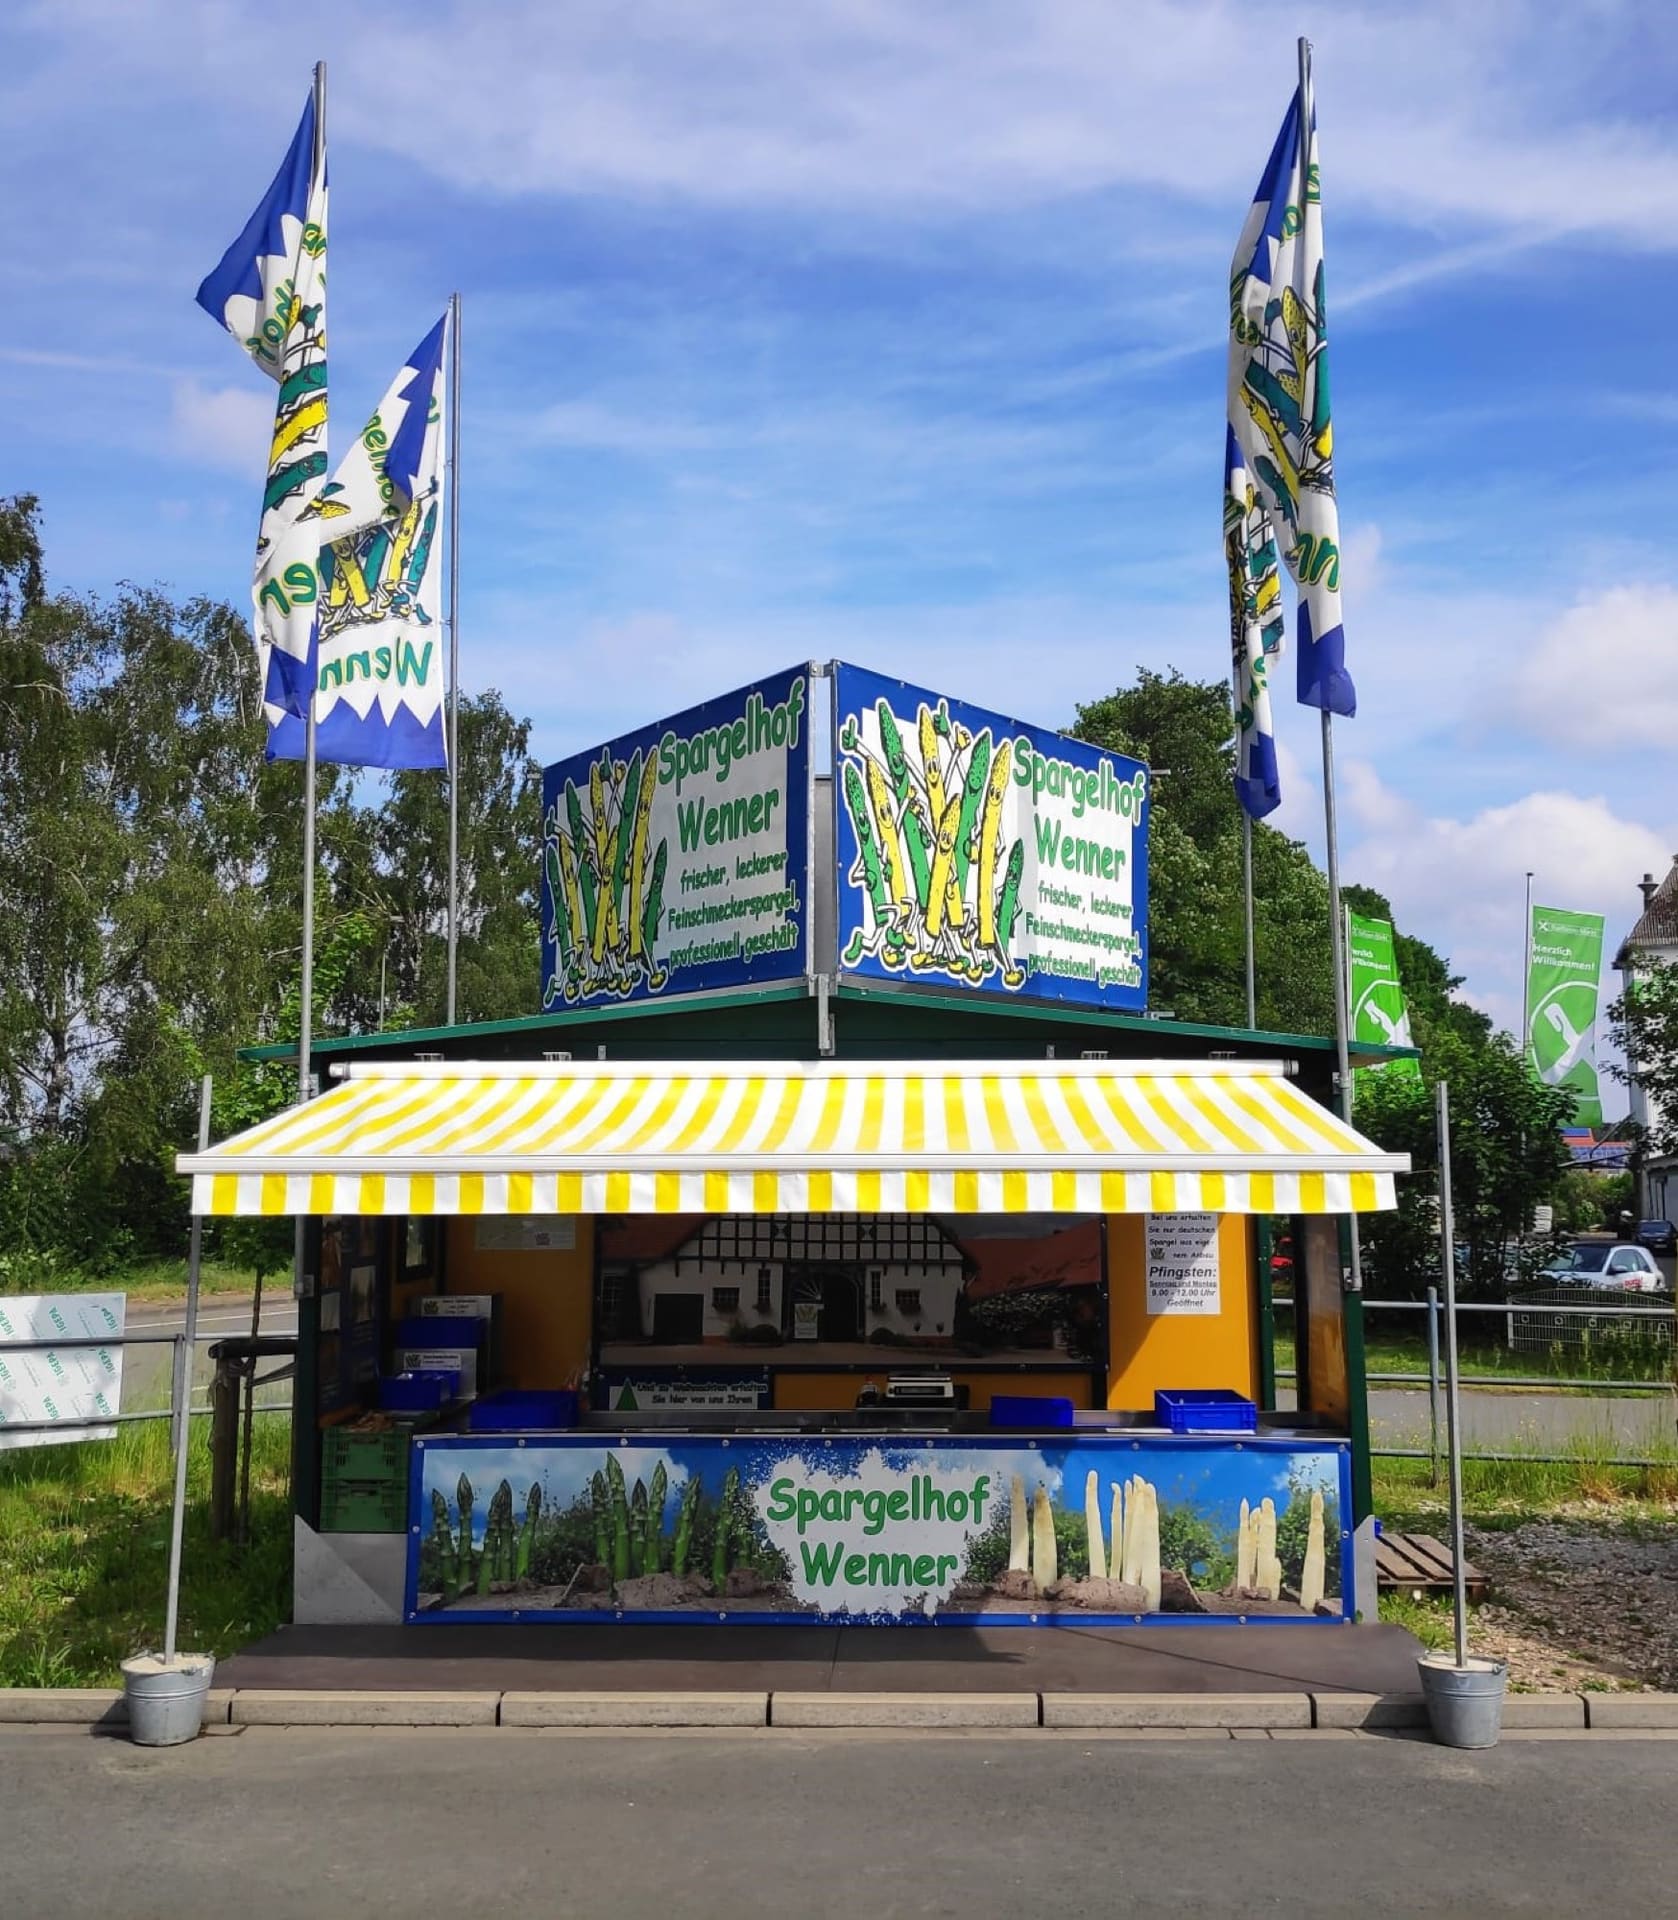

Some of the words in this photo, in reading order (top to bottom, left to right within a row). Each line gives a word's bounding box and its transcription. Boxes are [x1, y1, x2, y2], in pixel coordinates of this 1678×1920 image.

[658, 679, 804, 796] Spargelhof
[1013, 738, 1144, 825] Spargelhof
[677, 788, 779, 853] Wenner
[1034, 813, 1126, 882] Wenner
[681, 867, 730, 893] frischer,
[736, 851, 788, 879] leckerer
[668, 880, 801, 931] Feinschmeckerspargel,
[1038, 880, 1085, 914] frischer,
[1091, 890, 1133, 919] leckerer
[669, 932, 740, 972] professionell
[744, 921, 798, 963] geschält
[1025, 915, 1142, 958] Feinschmeckerspargel,
[1028, 951, 1095, 982] professionell
[1099, 962, 1142, 988] geschält
[1149, 1238, 1177, 1248] Spargel
[1149, 1265, 1217, 1280] Pfingsten:
[1200, 1288, 1216, 1296] Uhr
[1167, 1298, 1204, 1308] Geöffnet
[47, 1351, 65, 1377] IGEPA
[652, 1394, 666, 1404] Sie
[670, 1394, 687, 1404] hier
[690, 1395, 706, 1403] von
[730, 1381, 768, 1392] erhalten
[766, 1475, 991, 1536] Spargelhof
[799, 1541, 958, 1587] Wenner
